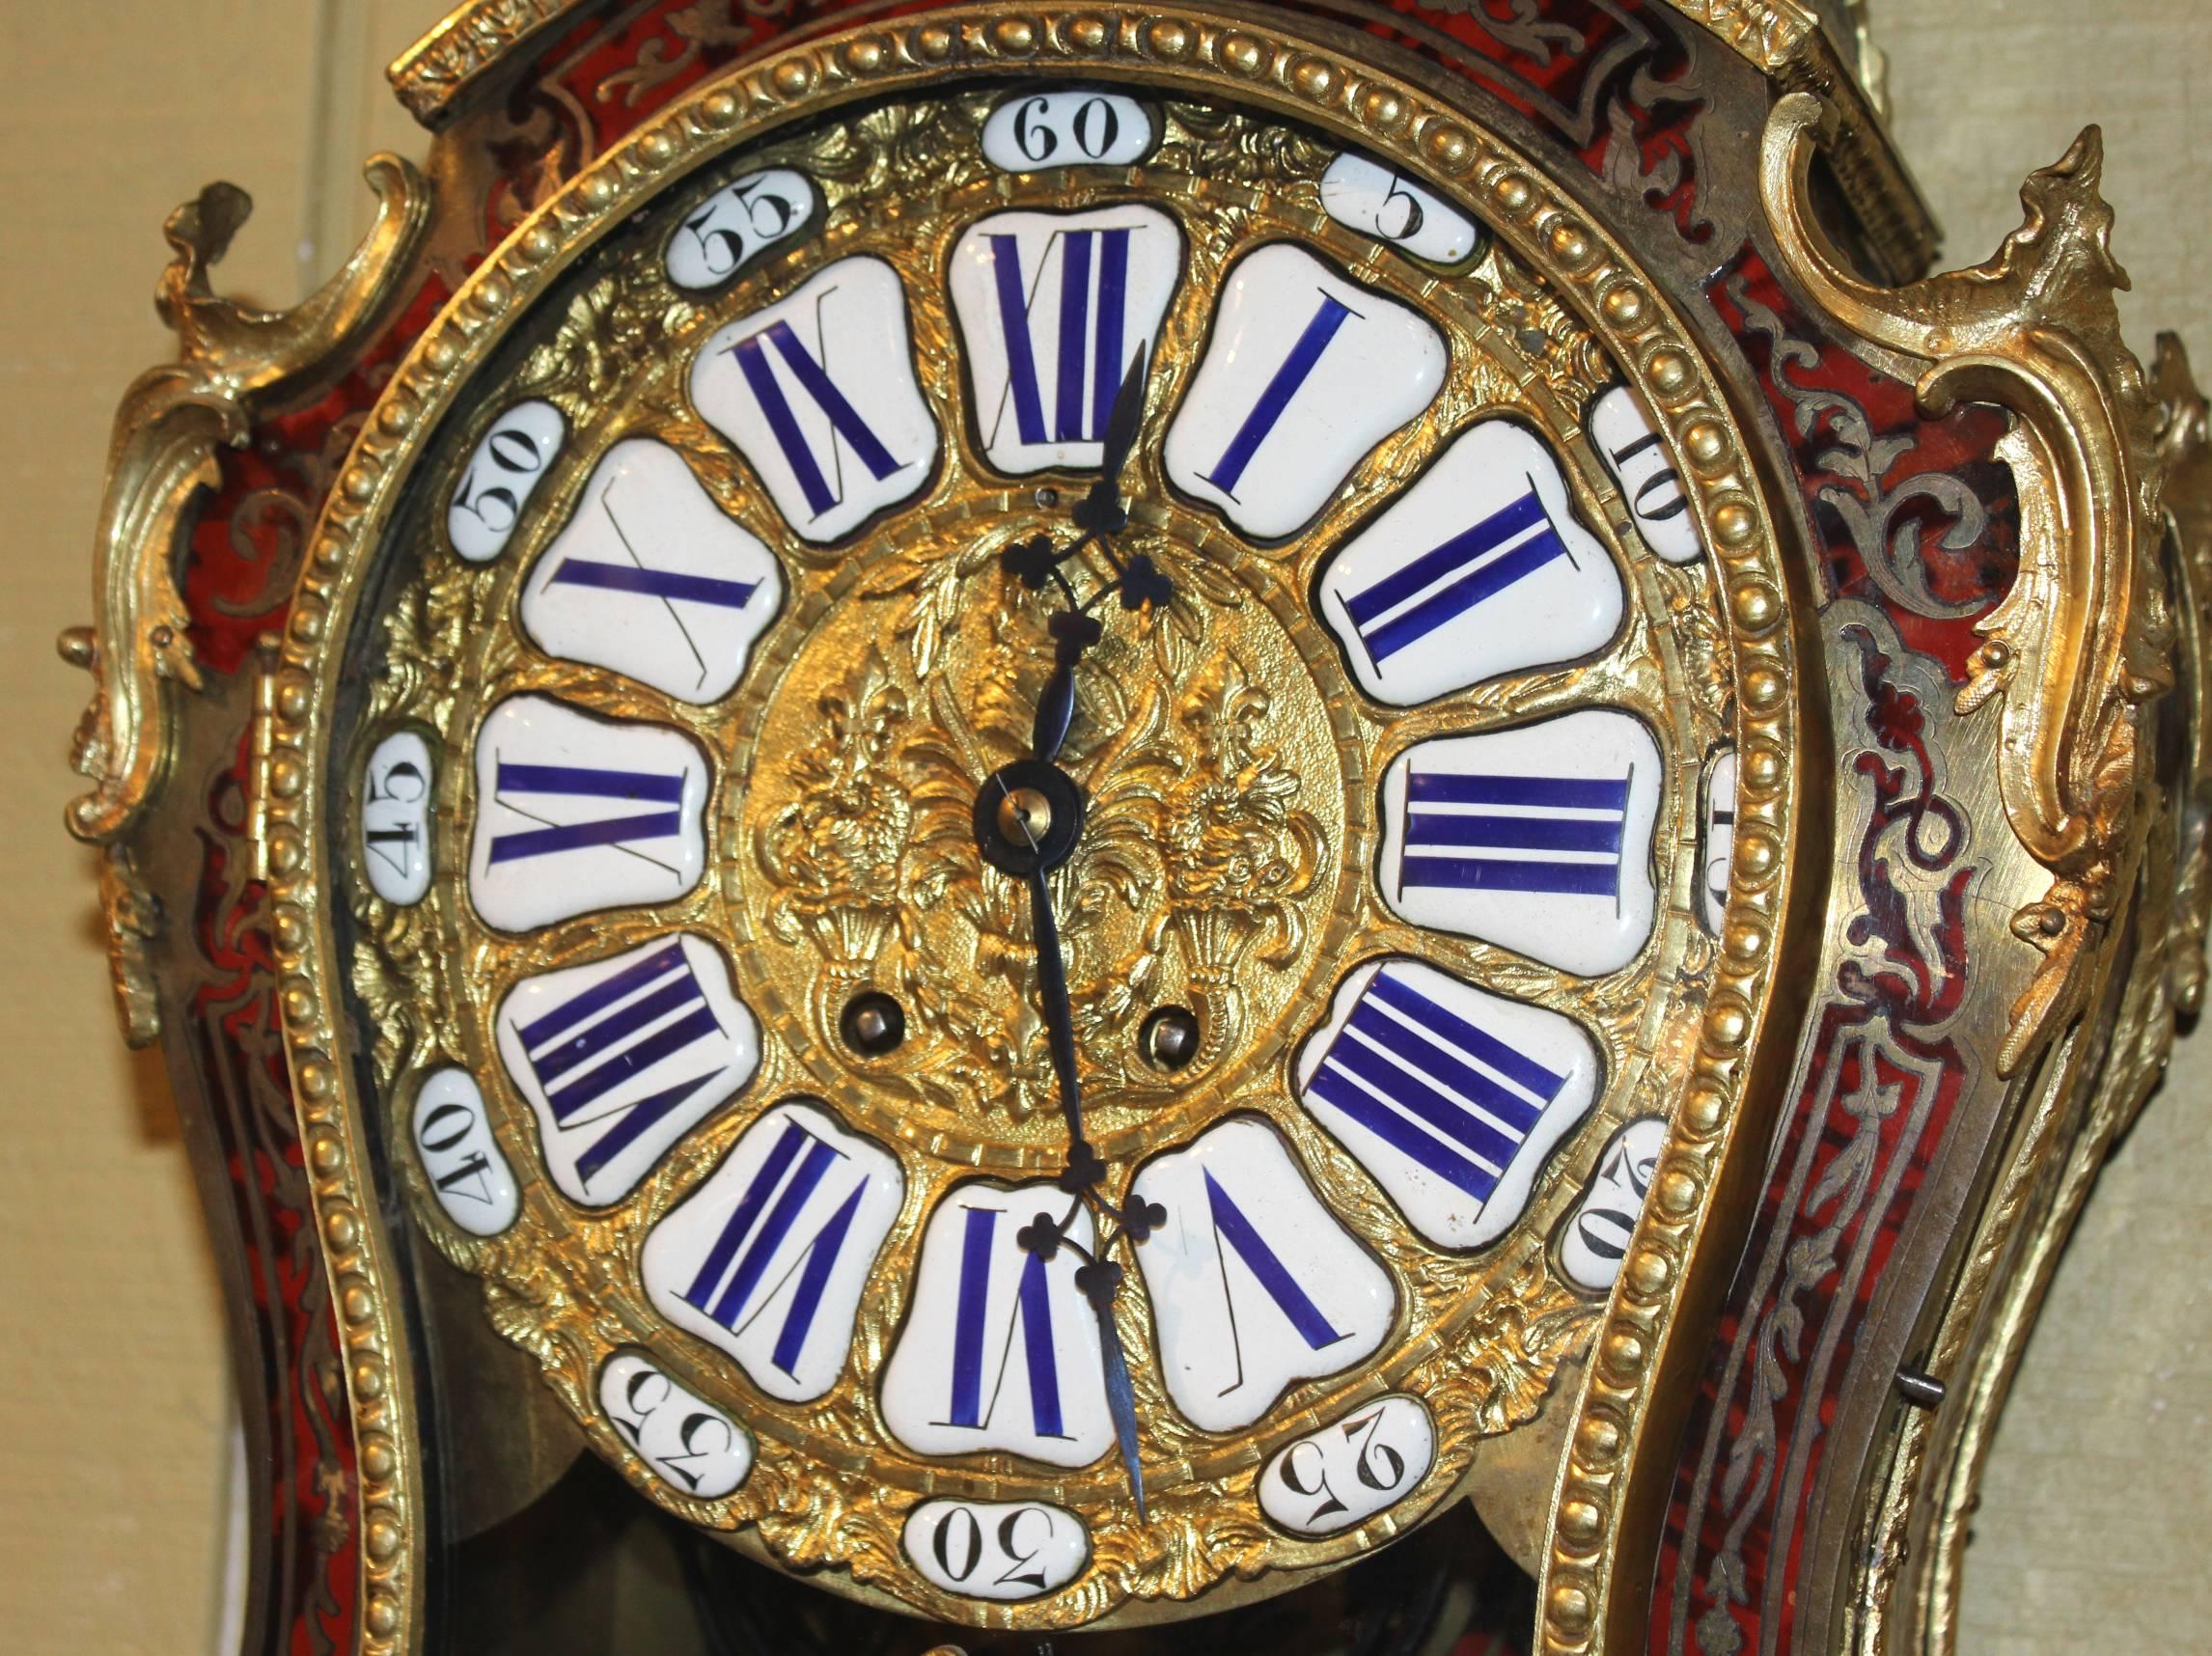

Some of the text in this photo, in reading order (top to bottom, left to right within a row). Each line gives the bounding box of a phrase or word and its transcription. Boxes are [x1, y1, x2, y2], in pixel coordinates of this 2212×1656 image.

[1013, 97, 1120, 162] 60
[686, 174, 792, 275] 55
[1375, 175, 1424, 239] 5
[979, 225, 1148, 451] XII
[1193, 286, 1366, 506] I
[453, 428, 542, 534] 50
[1608, 431, 1689, 522] 10
[541, 476, 765, 691] X
[1334, 471, 1581, 679] II
[365, 761, 427, 880] 45
[1397, 758, 1635, 920] III
[510, 934, 730, 1197] VIII
[1302, 962, 1574, 1225] IIII
[421, 1103, 494, 1206] 40
[1578, 1135, 1658, 1259] 20
[669, 1113, 871, 1386] VII
[1202, 1162, 1356, 1398] V
[927, 1204, 1078, 1442] VI
[610, 1370, 733, 1492] 35
[1279, 1405, 1405, 1527] 25
[932, 1505, 1054, 1590] 30
